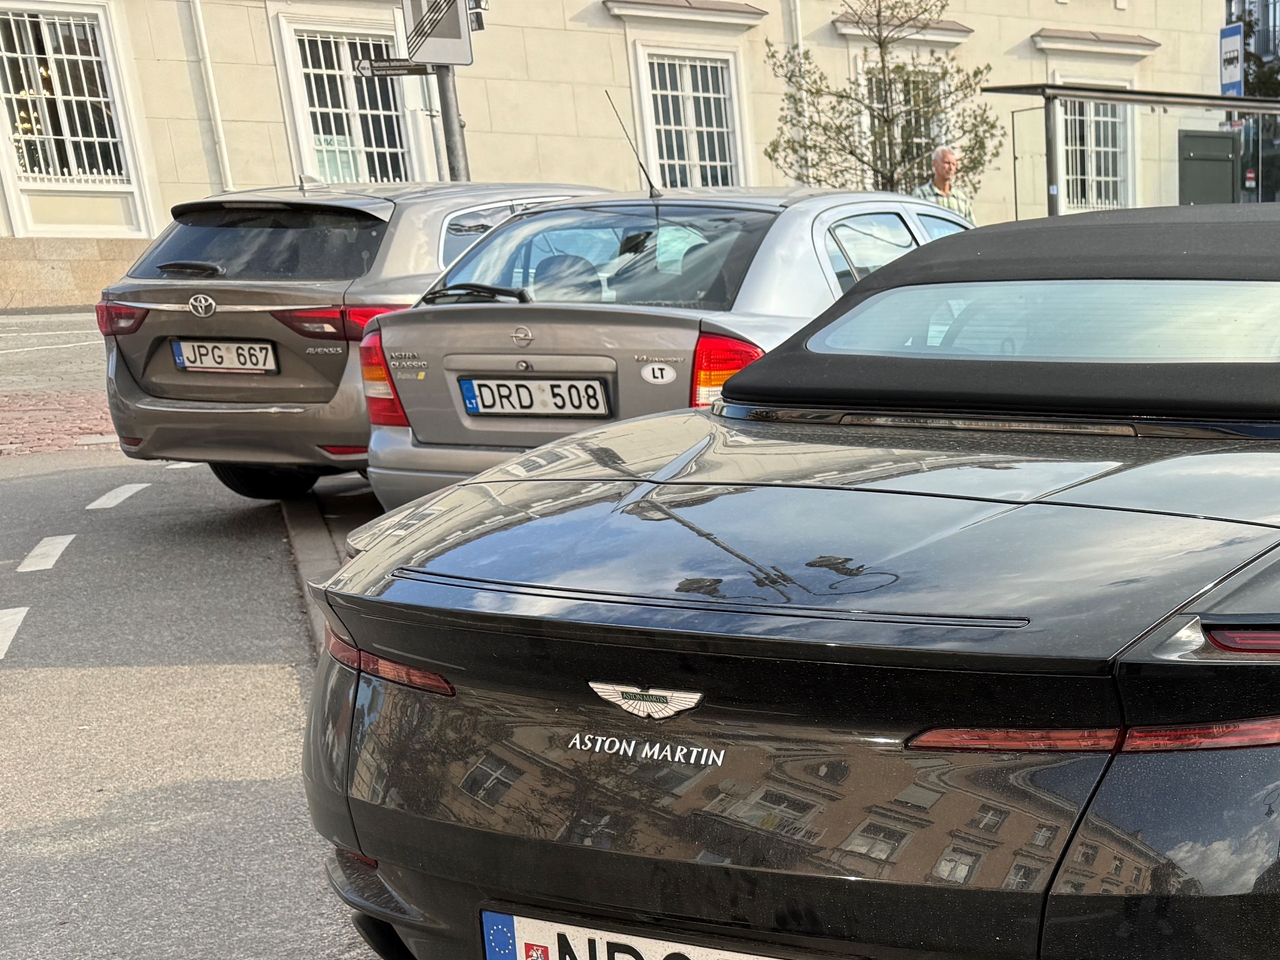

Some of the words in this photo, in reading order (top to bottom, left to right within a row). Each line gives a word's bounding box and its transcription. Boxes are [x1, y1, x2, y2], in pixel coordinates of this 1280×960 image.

[186, 344, 224, 366] JPG
[236, 345, 269, 367] 667
[652, 367, 665, 379] LT
[465, 399, 477, 408] LT
[477, 383, 533, 410] DRD
[550, 384, 600, 410] 508
[623, 692, 643, 700] ASTON
[643, 695, 667, 703] MARTIN
[568, 733, 636, 757] ASTON
[641, 742, 726, 766] MARTIN
